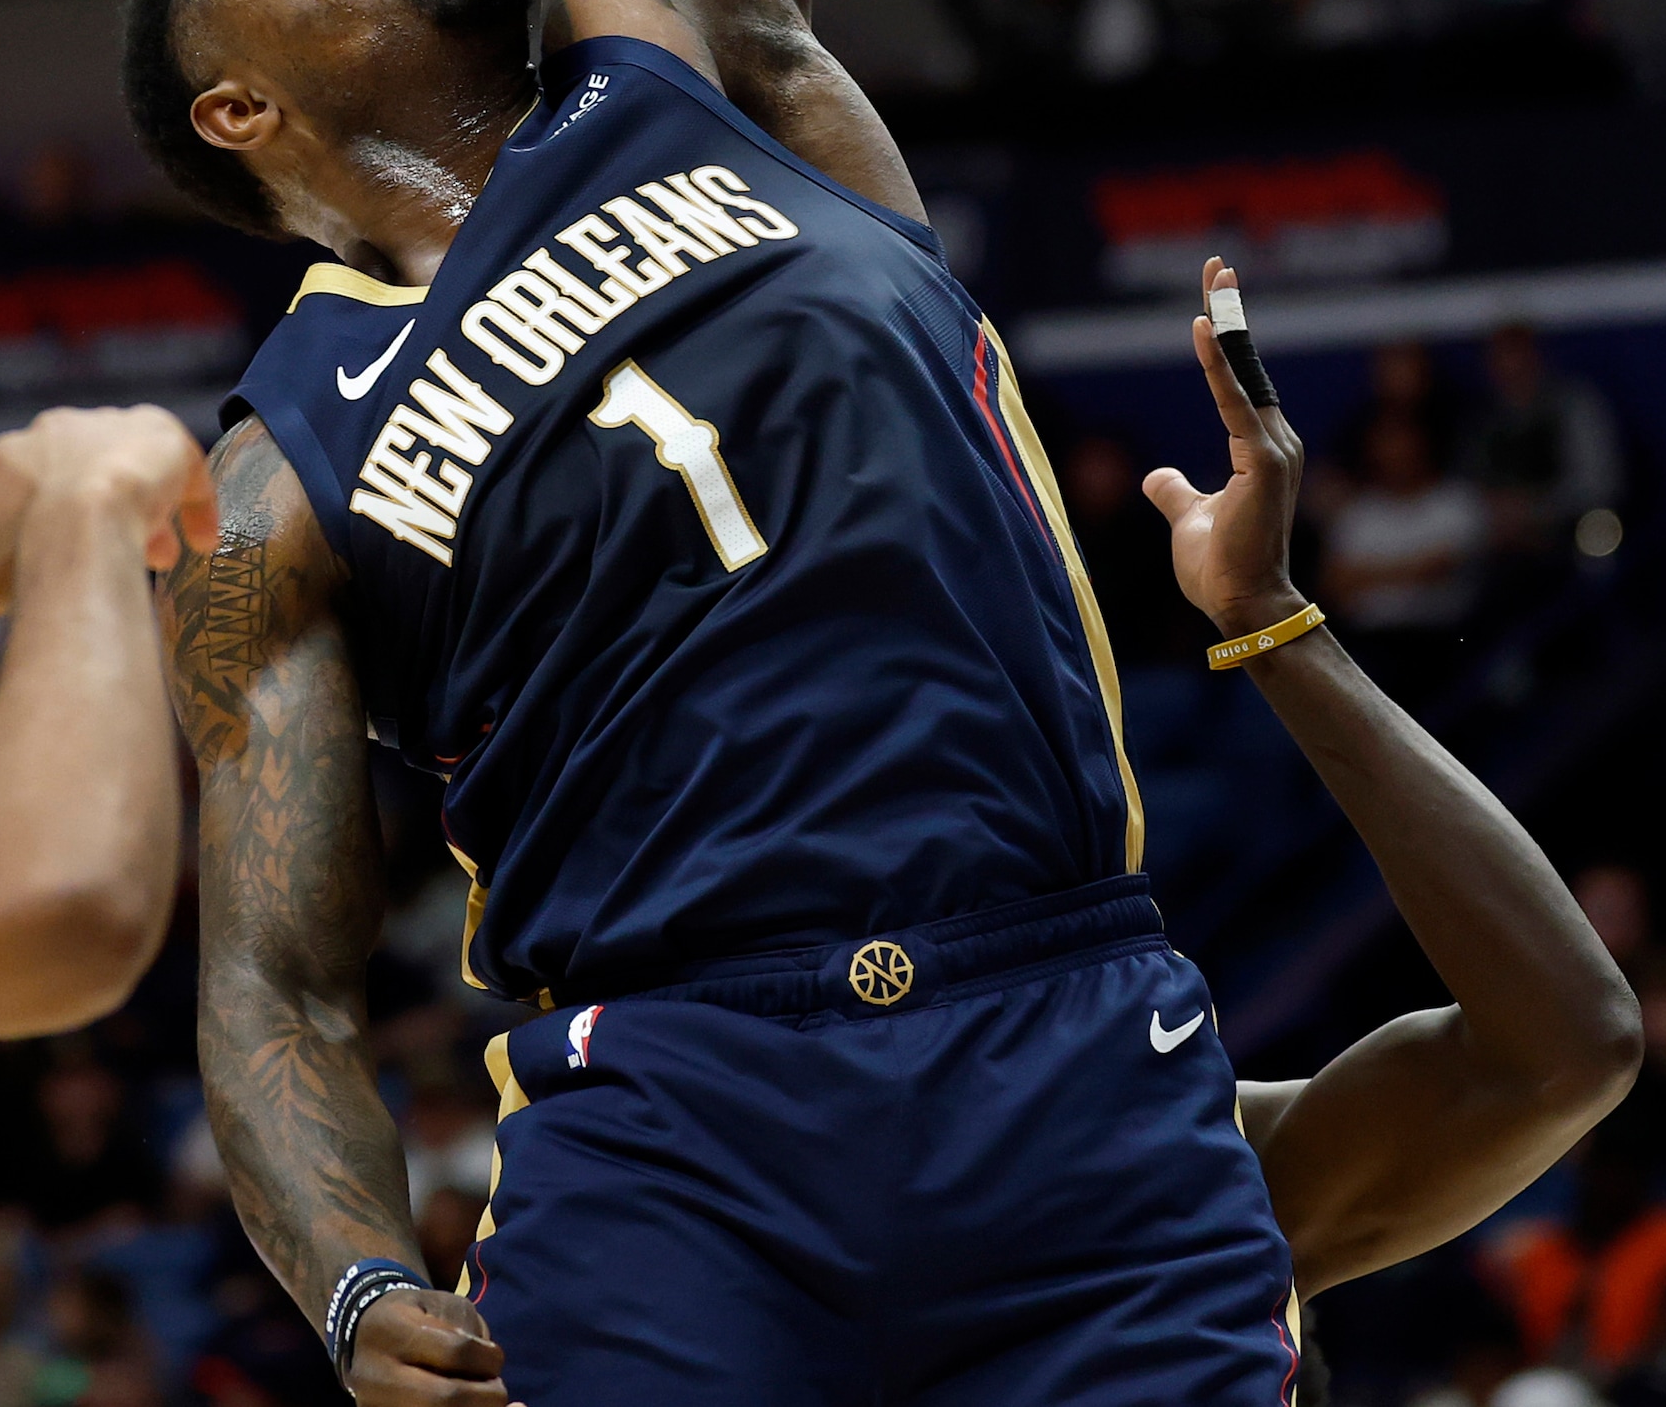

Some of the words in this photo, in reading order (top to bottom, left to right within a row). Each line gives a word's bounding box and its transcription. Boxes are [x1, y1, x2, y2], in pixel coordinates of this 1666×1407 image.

[349, 347, 514, 567] NEW
[461, 163, 799, 387] ORLEANS
[587, 358, 769, 574] 1
[359, 1288, 381, 1309] TO
